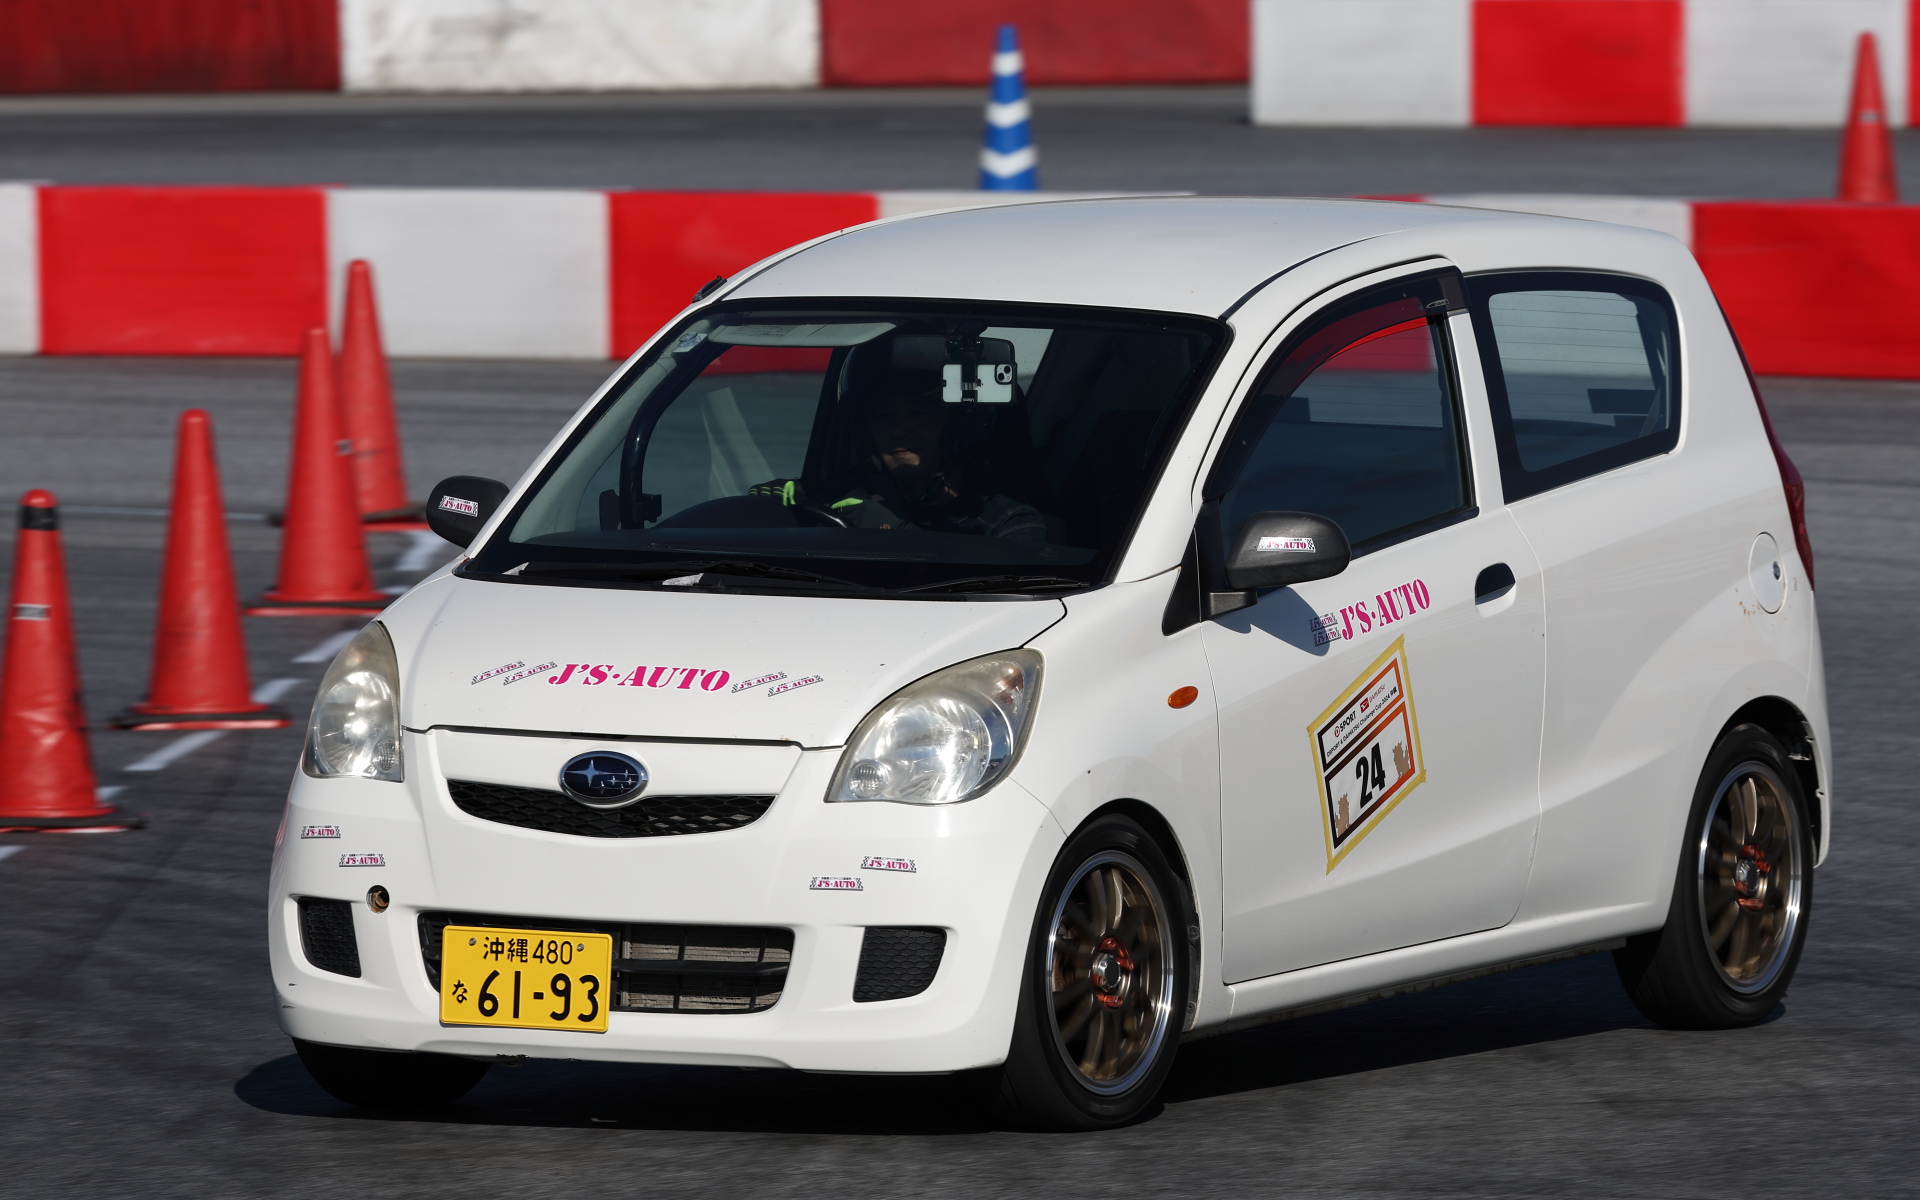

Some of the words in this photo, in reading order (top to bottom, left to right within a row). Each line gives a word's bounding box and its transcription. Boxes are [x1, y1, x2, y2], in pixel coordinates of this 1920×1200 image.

[1356, 742, 1386, 808] 24
[452, 979, 469, 1004] な
[477, 969, 600, 1023] 61-93
